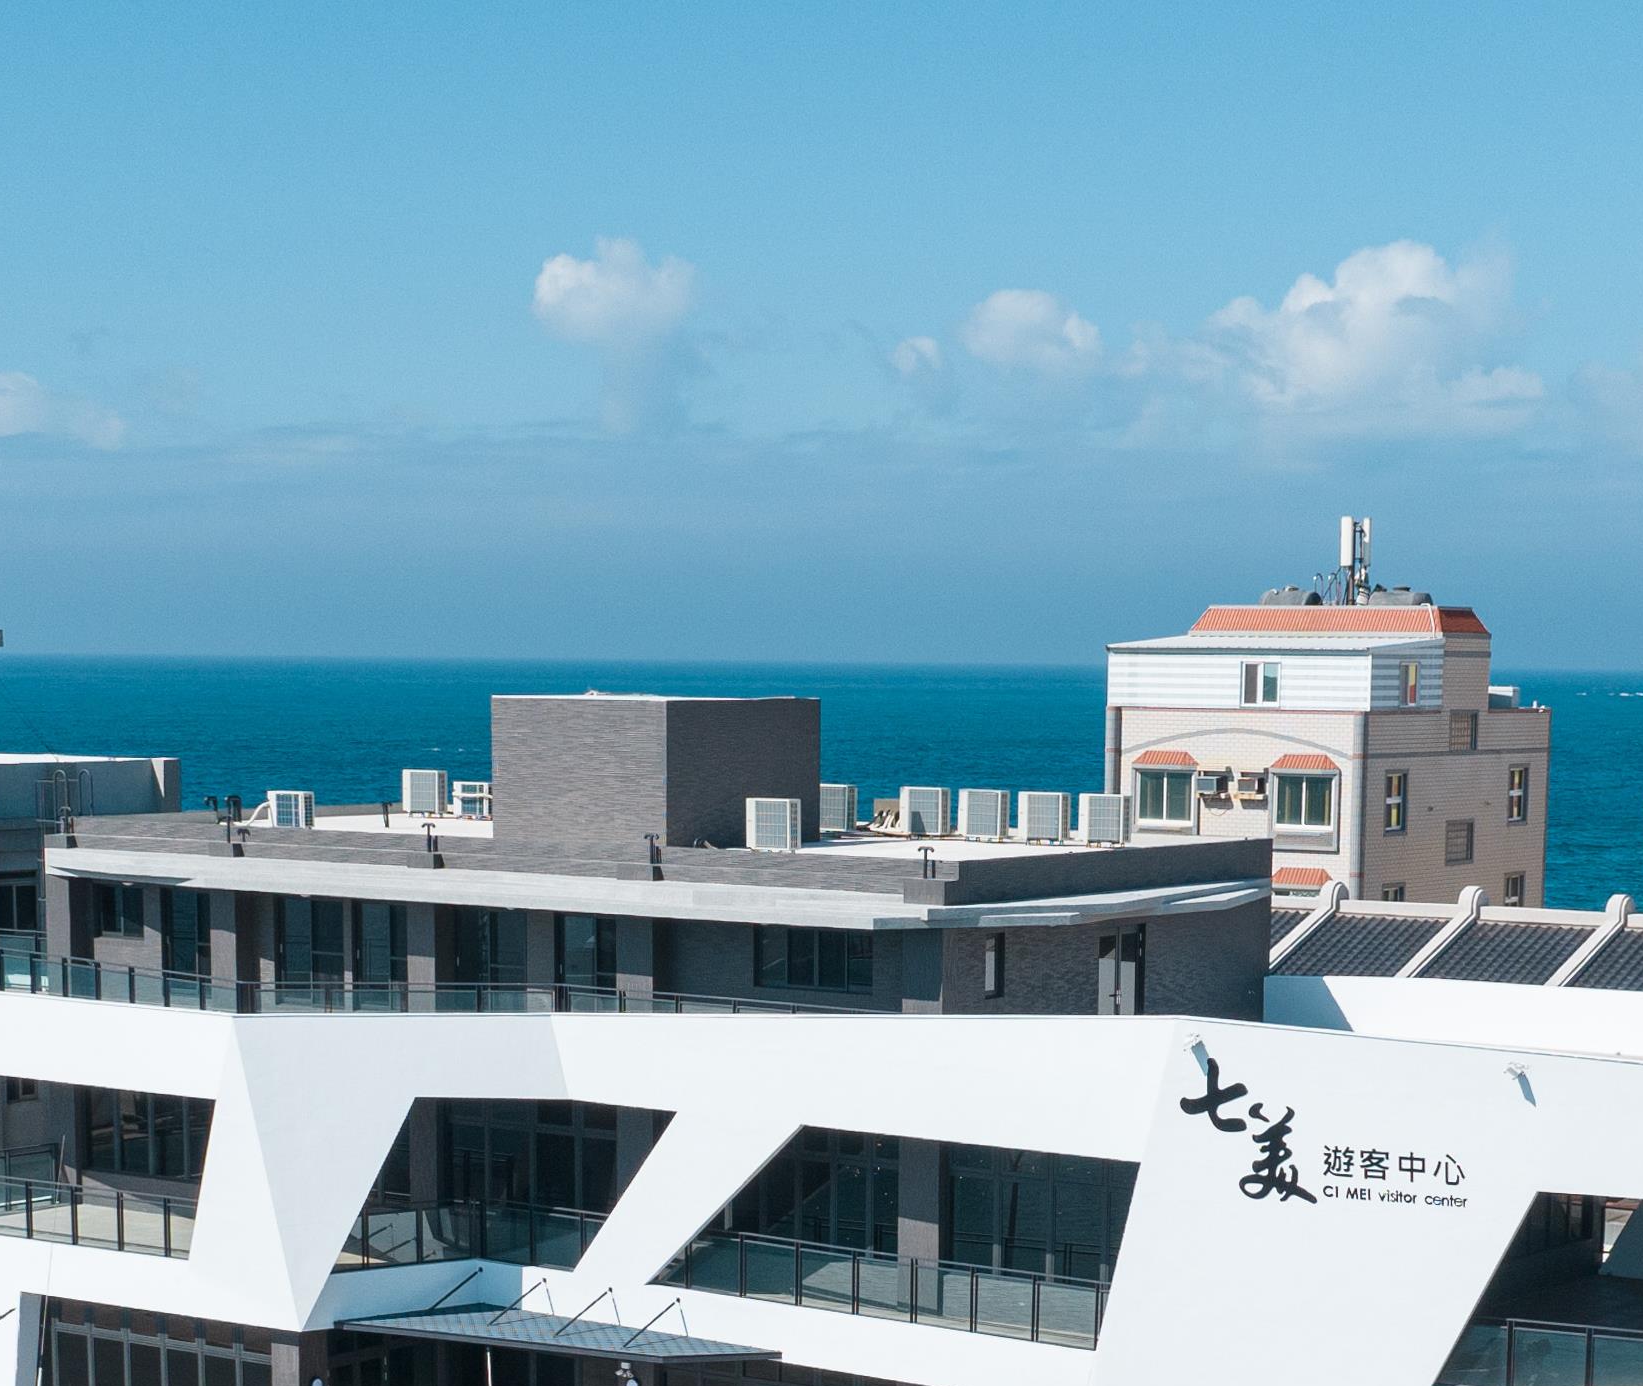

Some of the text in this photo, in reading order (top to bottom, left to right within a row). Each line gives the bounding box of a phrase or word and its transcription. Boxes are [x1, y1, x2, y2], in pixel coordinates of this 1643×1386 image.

[1180, 1057, 1318, 1204] 七美
[1323, 1145, 1466, 1186] 遊客中心
[1323, 1186, 1467, 1207] CI MEI visitor center
